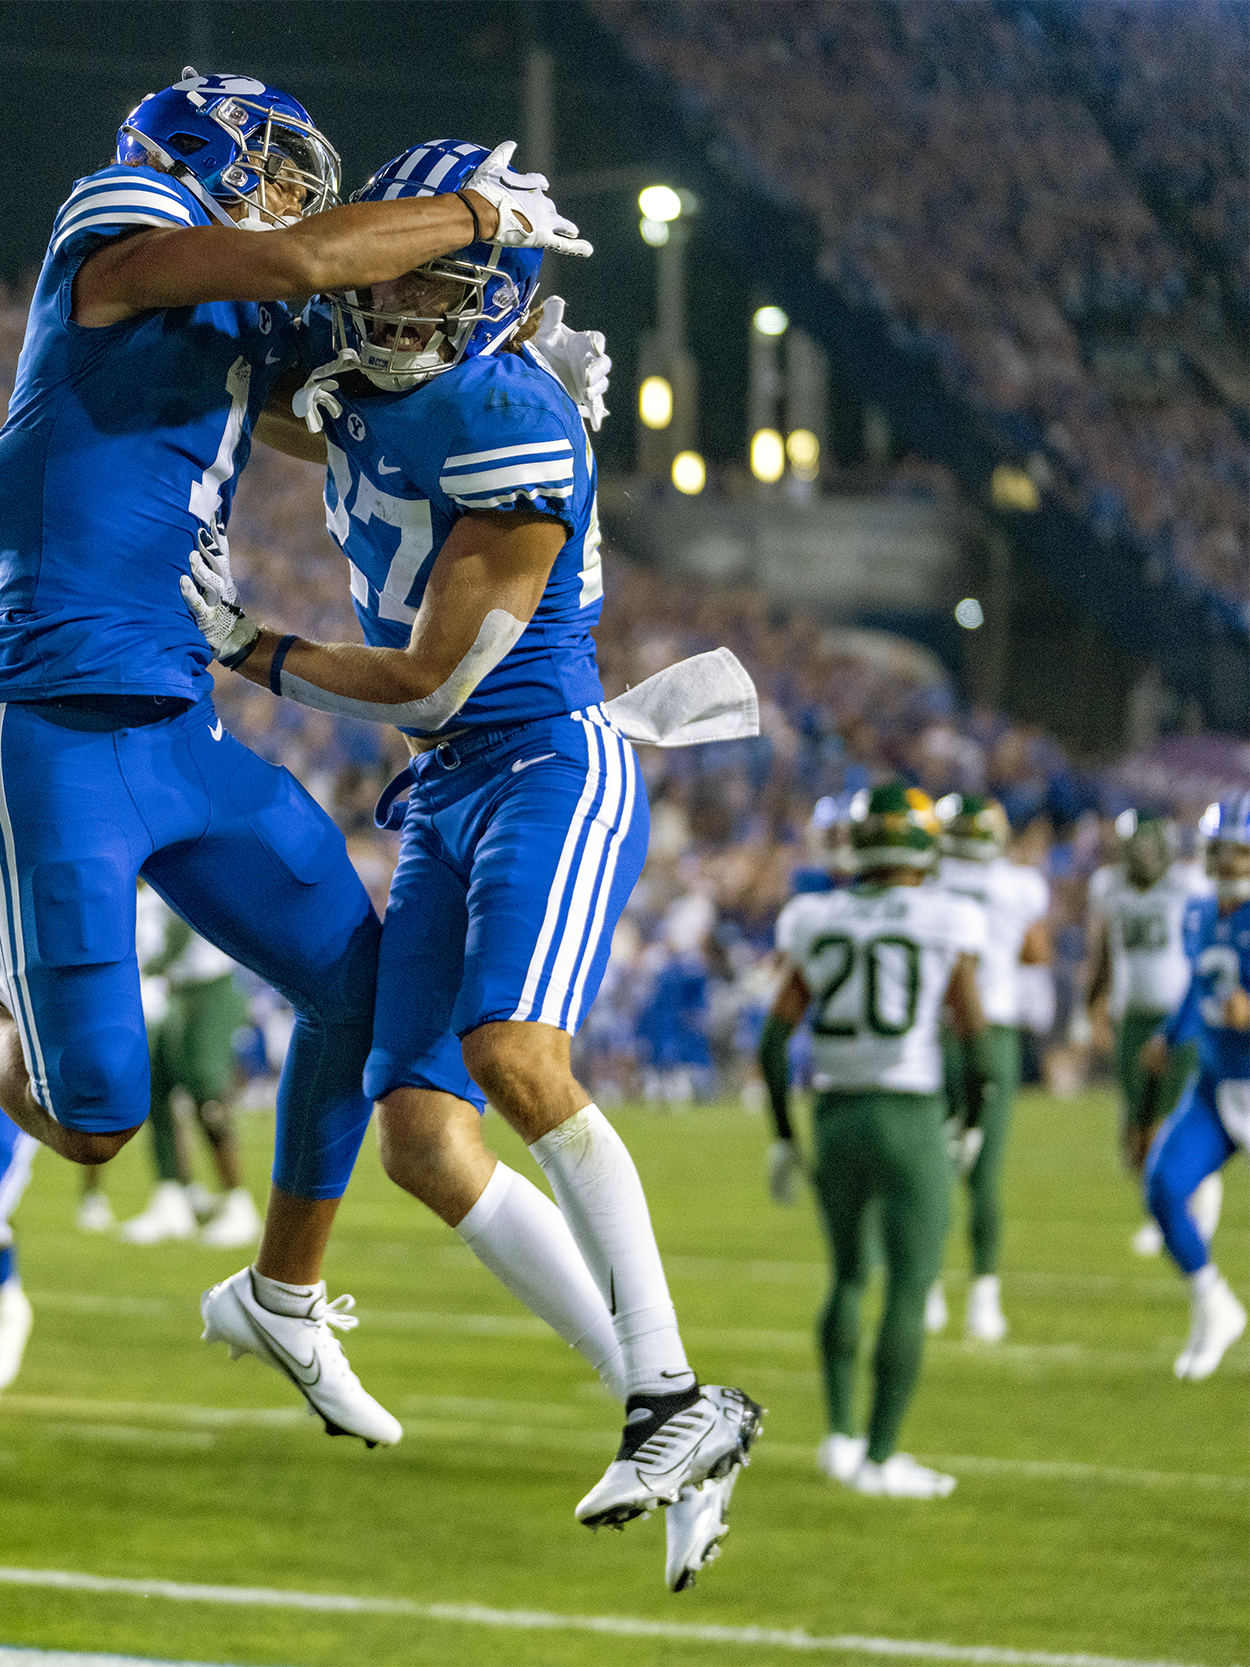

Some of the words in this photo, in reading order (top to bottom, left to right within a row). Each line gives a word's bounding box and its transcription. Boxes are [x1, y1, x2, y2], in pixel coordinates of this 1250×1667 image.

[188, 355, 252, 528] 1
[349, 416, 363, 438] Y
[810, 932, 922, 1036] 20
